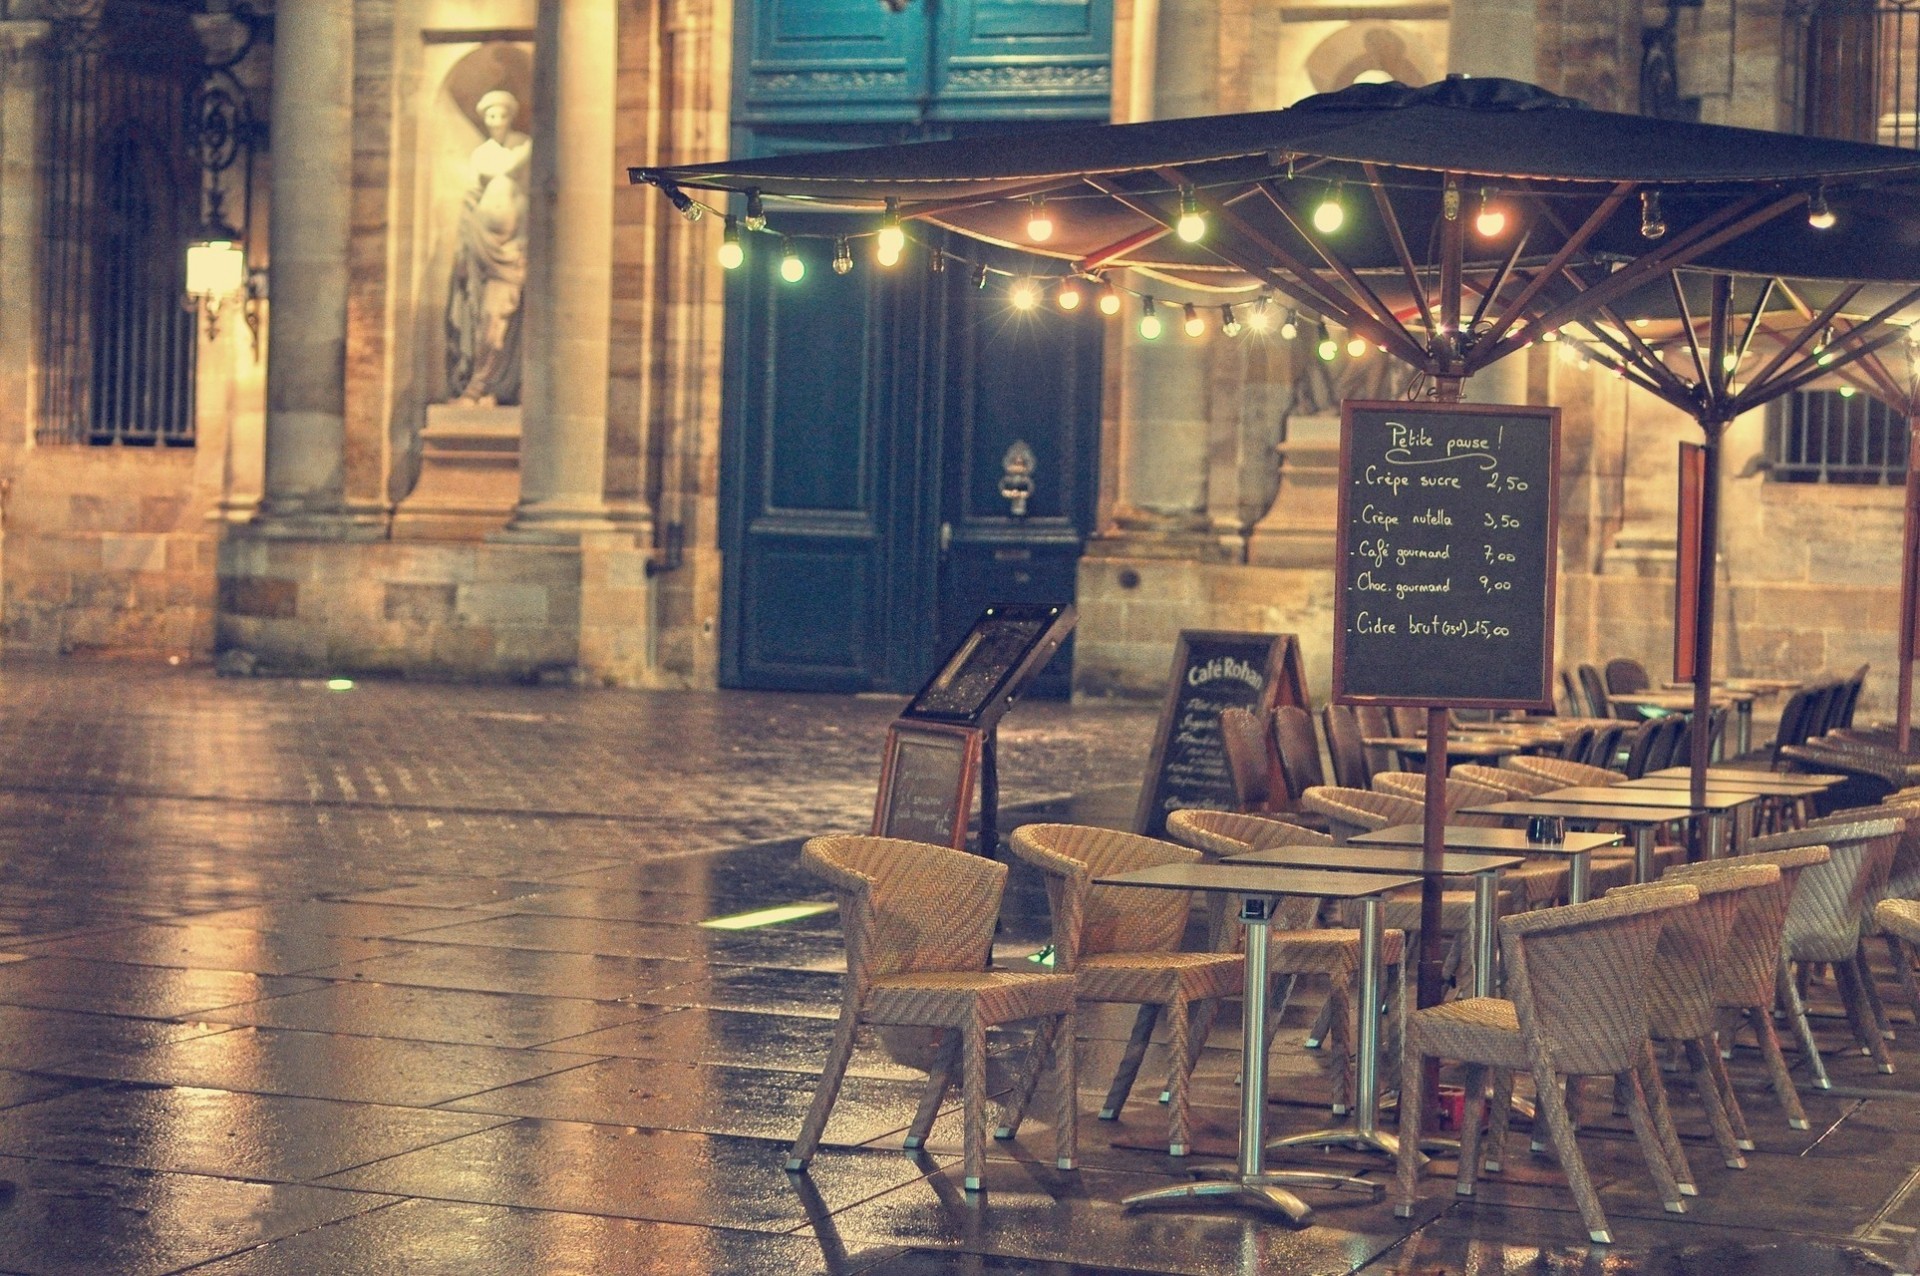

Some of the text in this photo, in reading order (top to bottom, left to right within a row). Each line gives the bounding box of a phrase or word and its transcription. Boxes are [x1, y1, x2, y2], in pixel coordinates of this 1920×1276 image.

[1385, 422, 1434, 448] Petite
[1446, 436, 1490, 456] pause
[1420, 476, 1462, 489] sucre
[1486, 472, 1529, 494] 2,50
[1412, 508, 1453, 526] nutella
[1483, 512, 1520, 530] 3,50
[1359, 539, 1516, 568] Café gourmand 7,00
[1395, 577, 1451, 600] gourmand
[1478, 575, 1512, 595] 9,00
[1356, 611, 1397, 635] Cidre
[1188, 656, 1263, 690] Café Rohan
